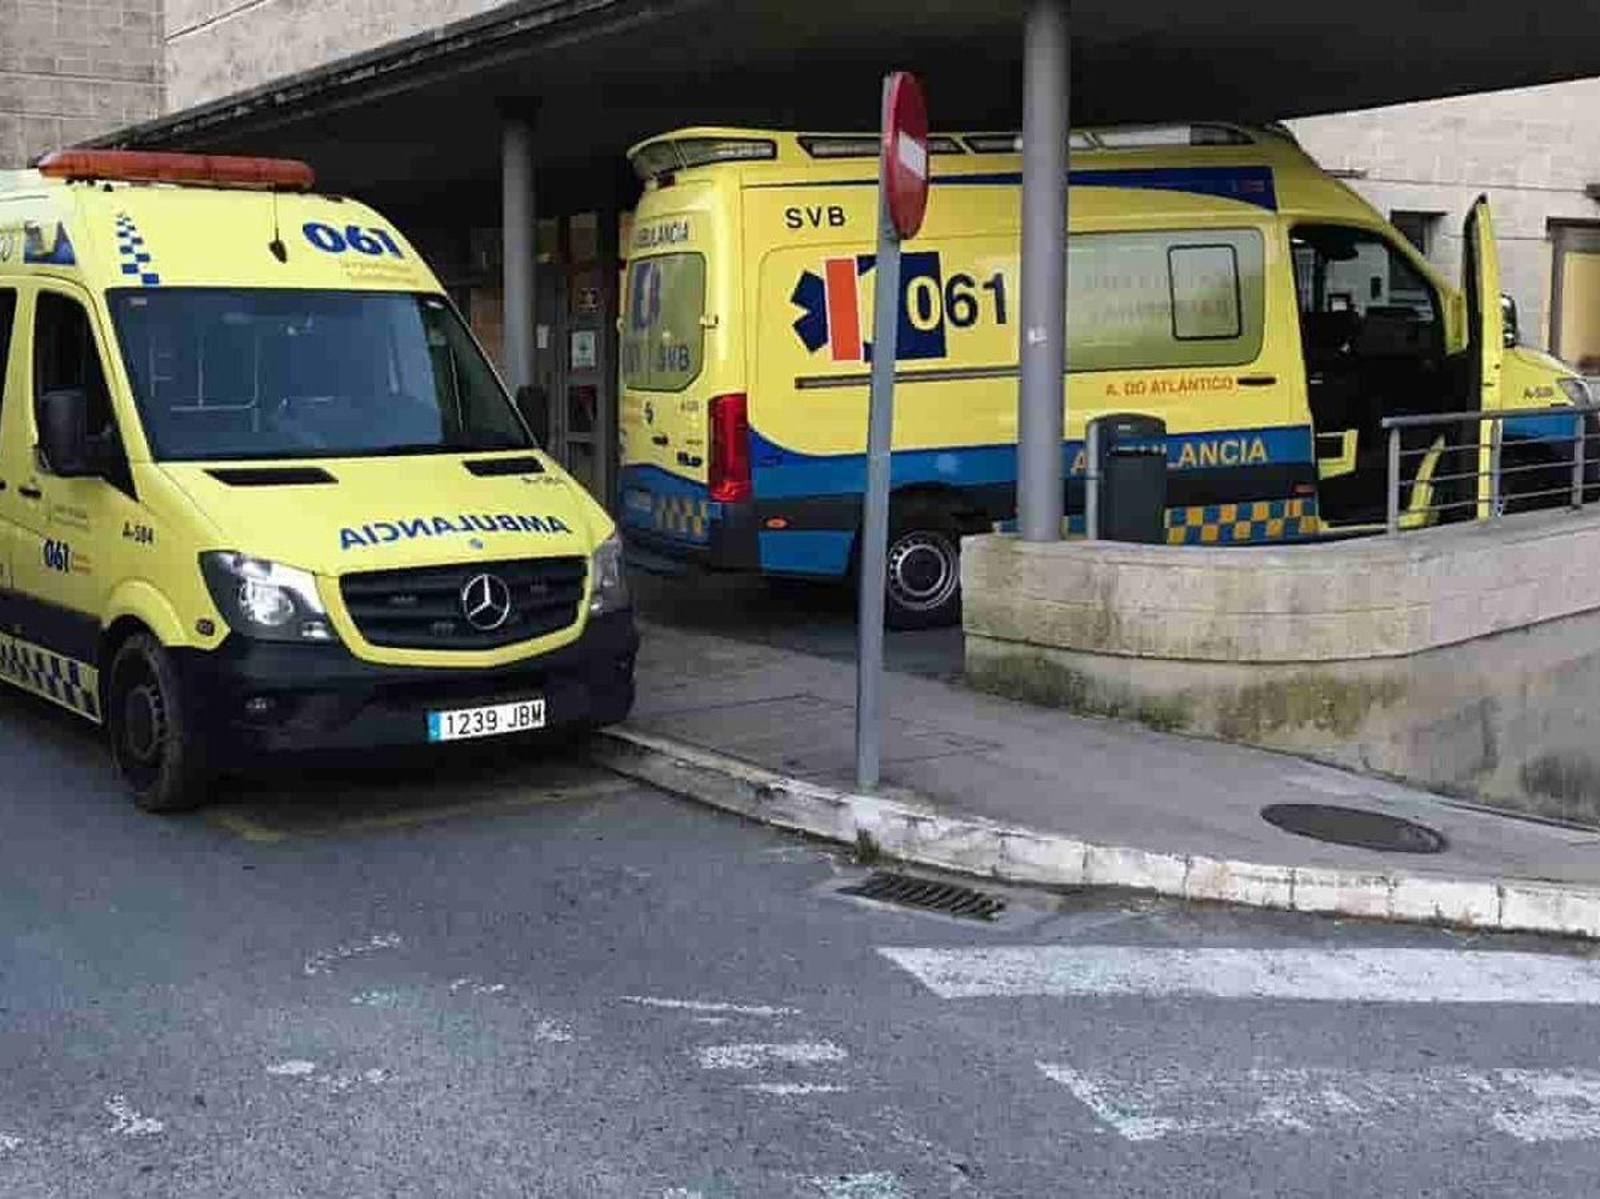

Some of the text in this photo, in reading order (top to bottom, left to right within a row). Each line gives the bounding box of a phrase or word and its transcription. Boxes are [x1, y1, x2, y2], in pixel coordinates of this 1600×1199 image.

[786, 206, 846, 228] SVB
[302, 223, 405, 259] 061
[906, 273, 1007, 331] 061
[44, 538, 70, 573] 061
[447, 703, 542, 735] 1239 JBM
